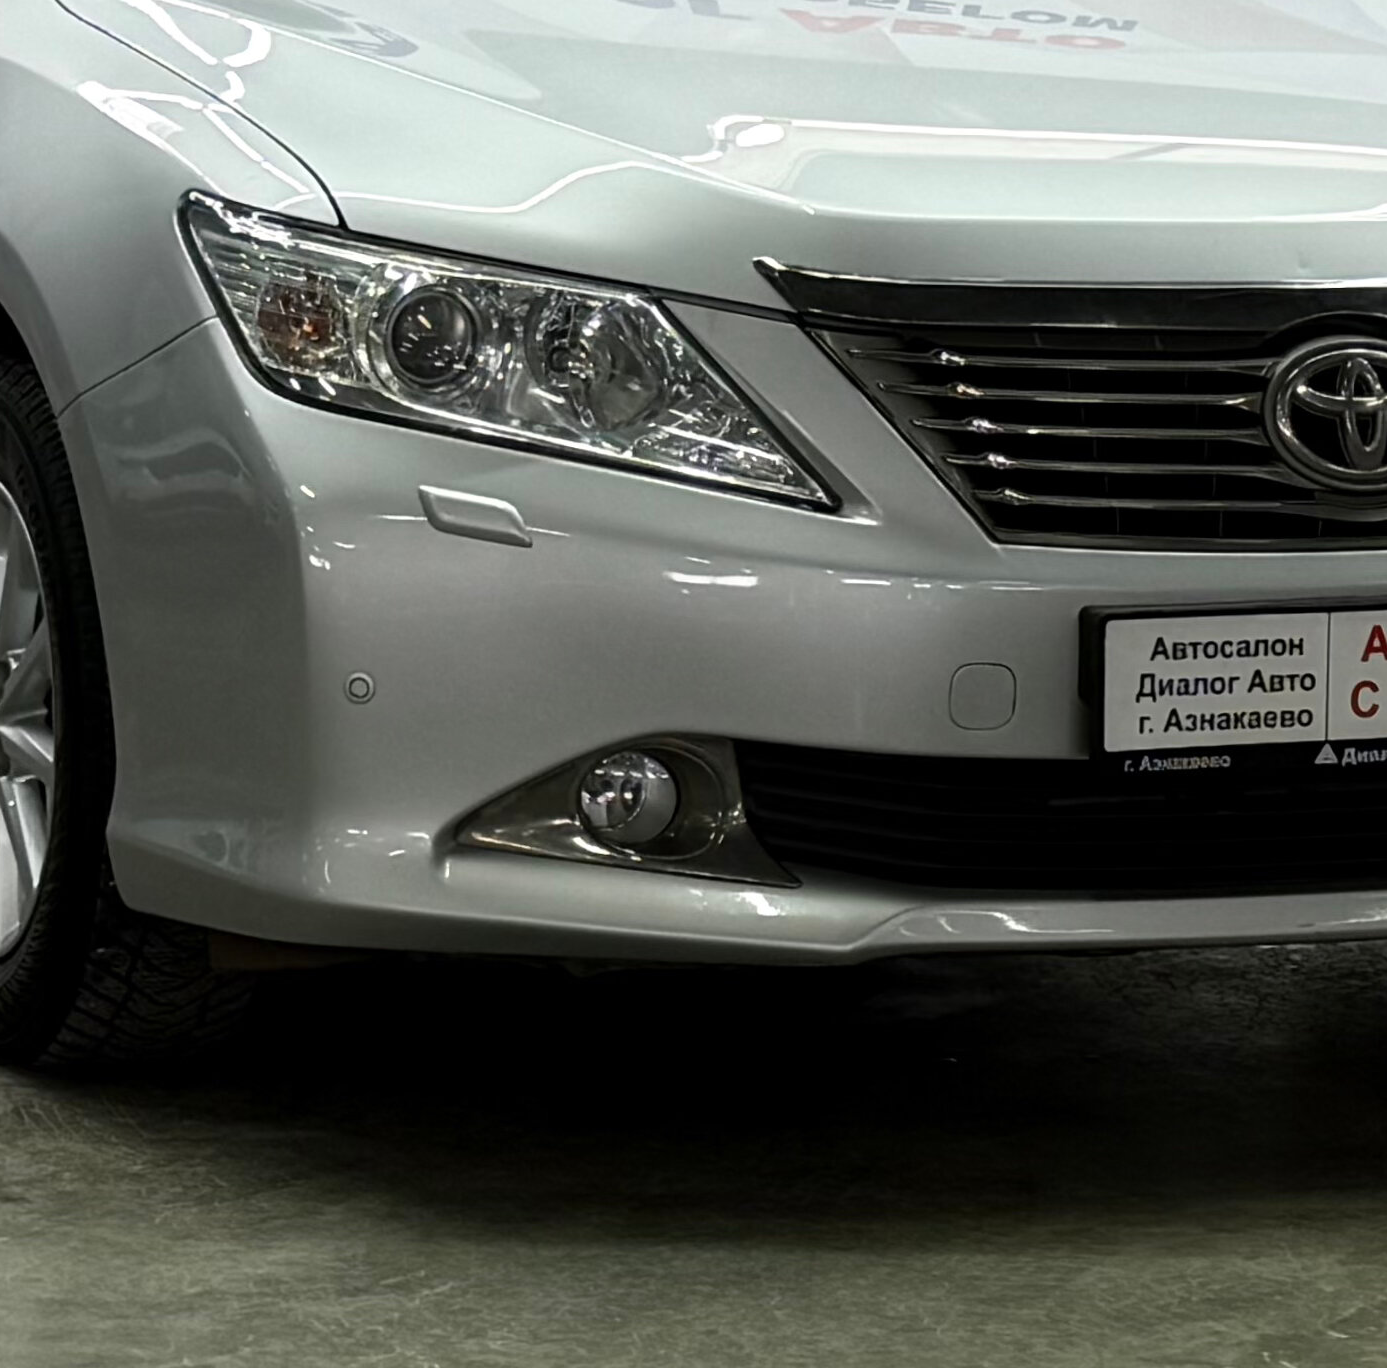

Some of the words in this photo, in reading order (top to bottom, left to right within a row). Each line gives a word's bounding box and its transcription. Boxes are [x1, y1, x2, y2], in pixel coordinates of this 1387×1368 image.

[1149, 636, 1305, 661] Автосалон
[1135, 672, 1240, 703] Диалог
[1246, 669, 1317, 694] Авто
[1350, 680, 1380, 719] С
[1138, 715, 1154, 734] г.
[1163, 707, 1314, 733] Азнакаево
